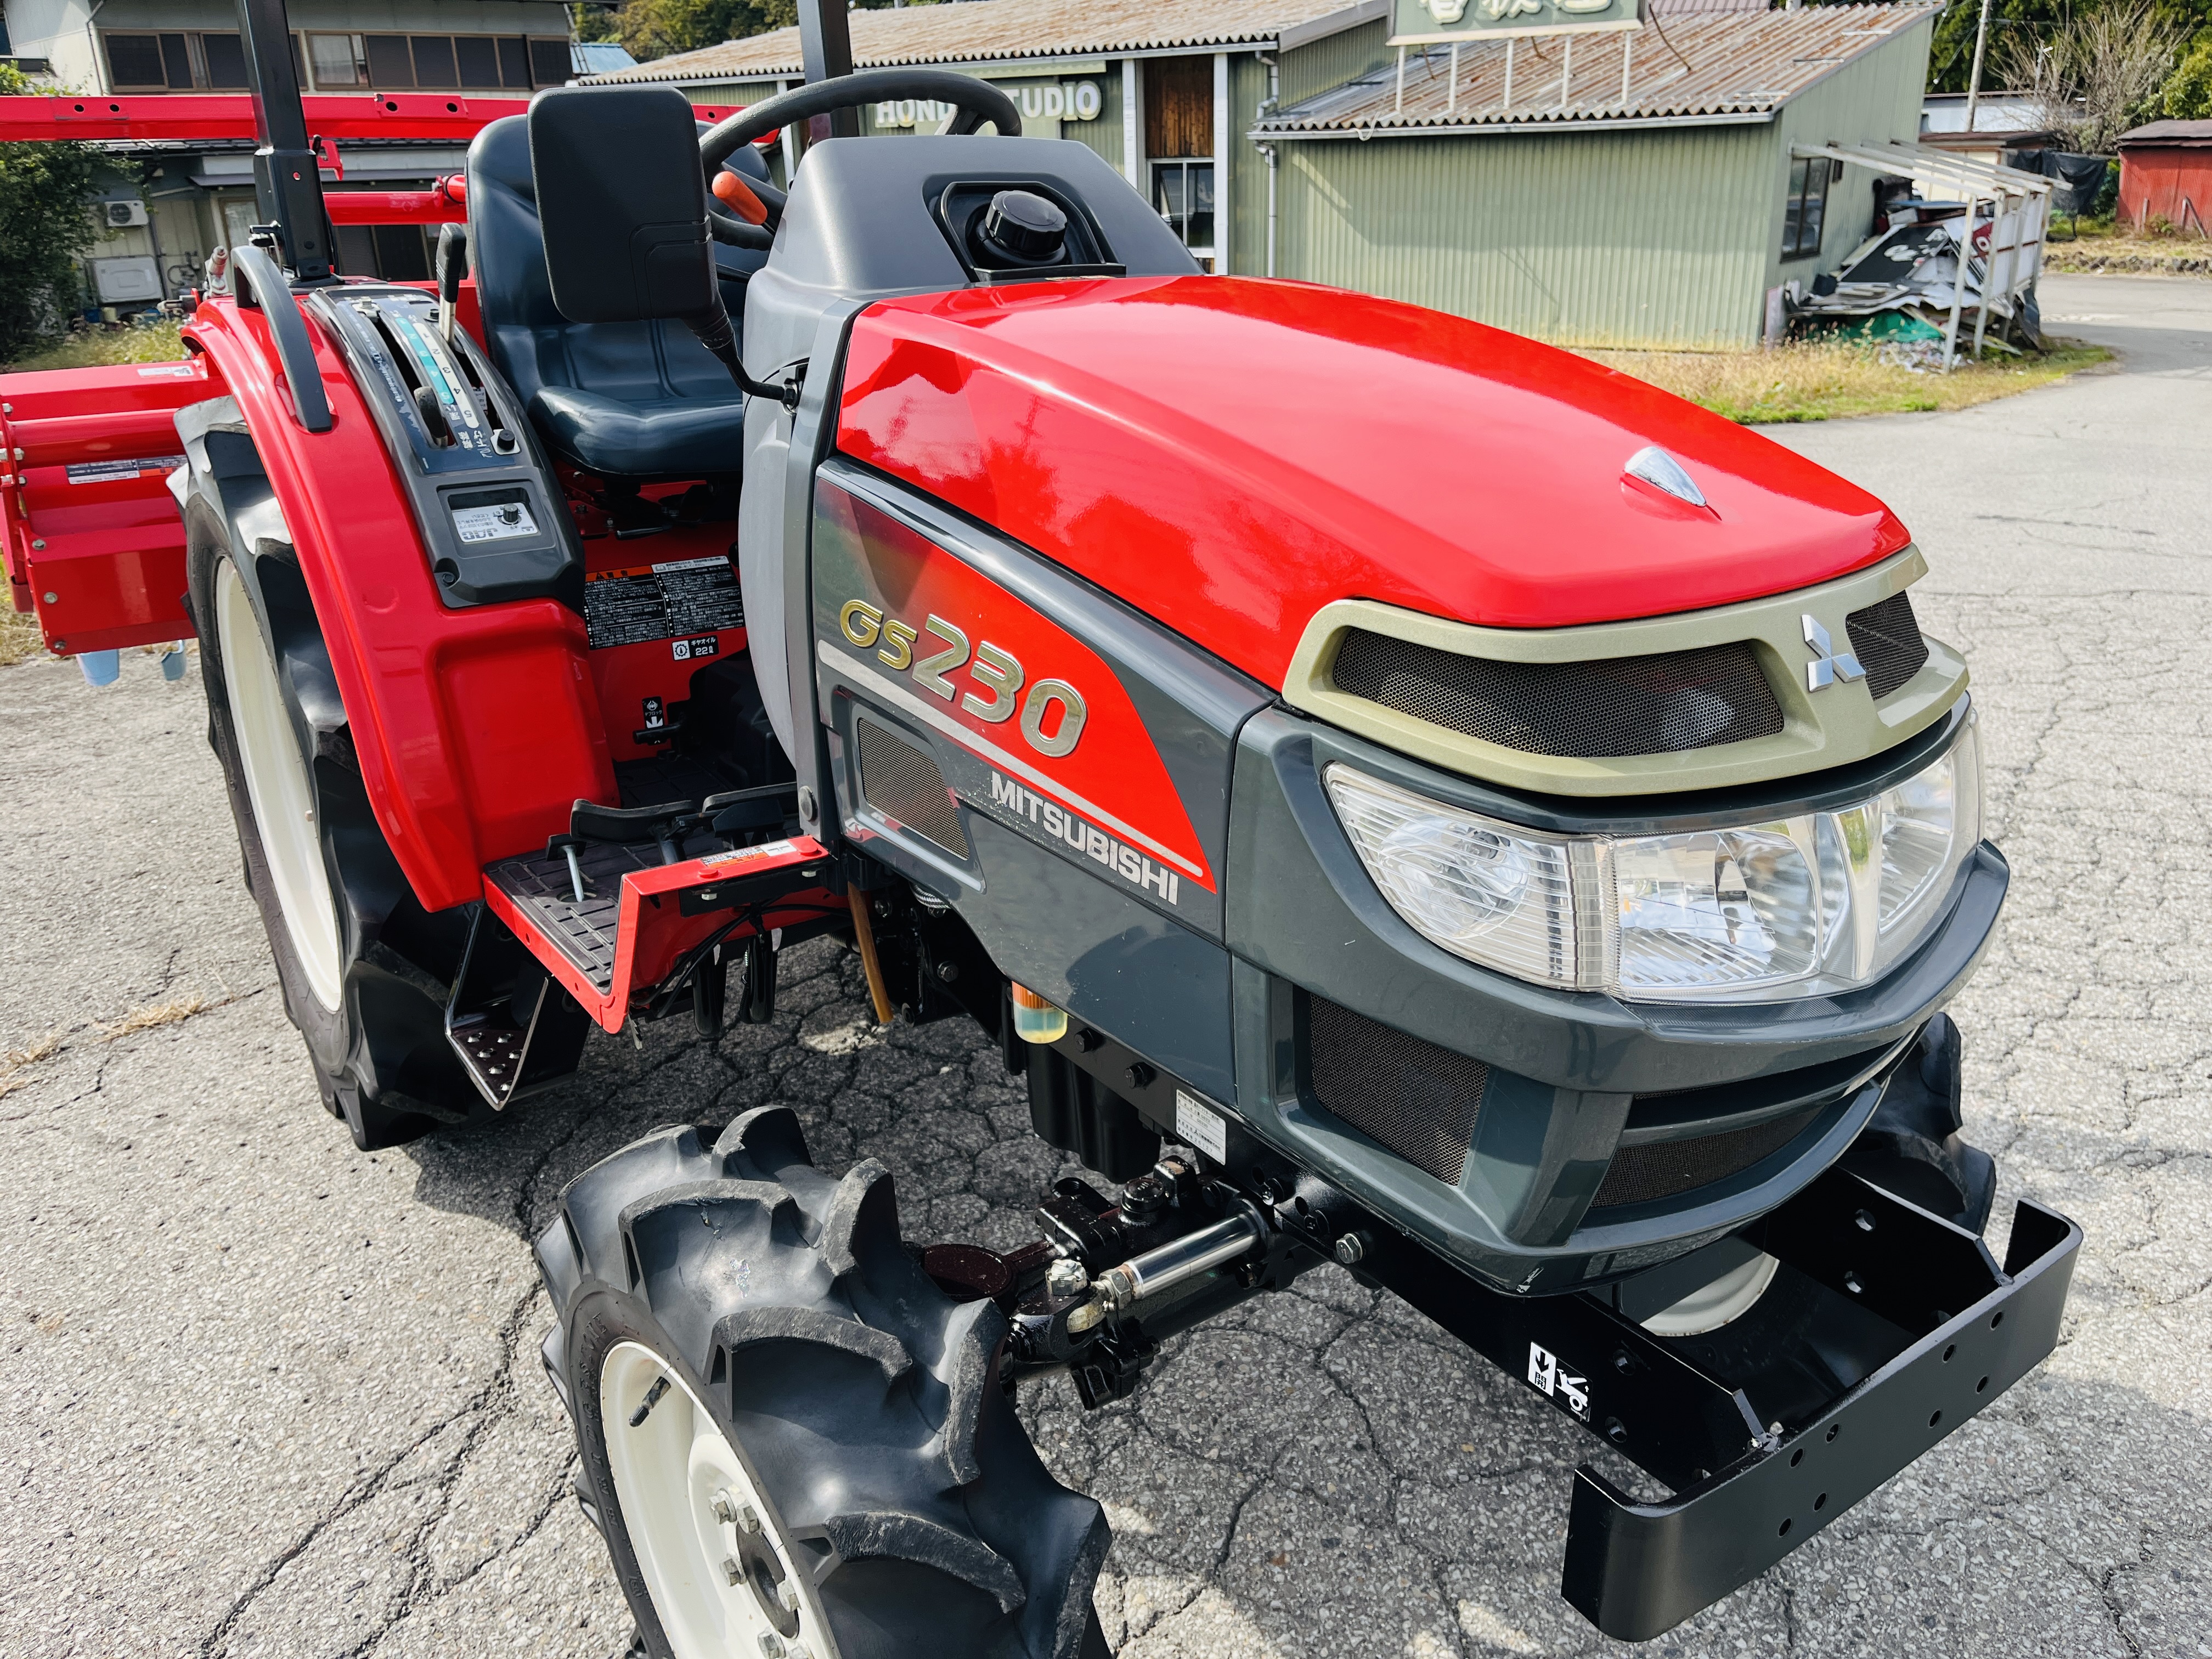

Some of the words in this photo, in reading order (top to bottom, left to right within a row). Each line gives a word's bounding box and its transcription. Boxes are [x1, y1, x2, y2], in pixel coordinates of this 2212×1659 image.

[876, 99, 958, 126] HOND
[464, 410, 472, 418] 5
[462, 528, 498, 540] JAC
[992, 771, 1178, 906] MITSUBISHI
[1535, 1372, 1547, 1390] 開
